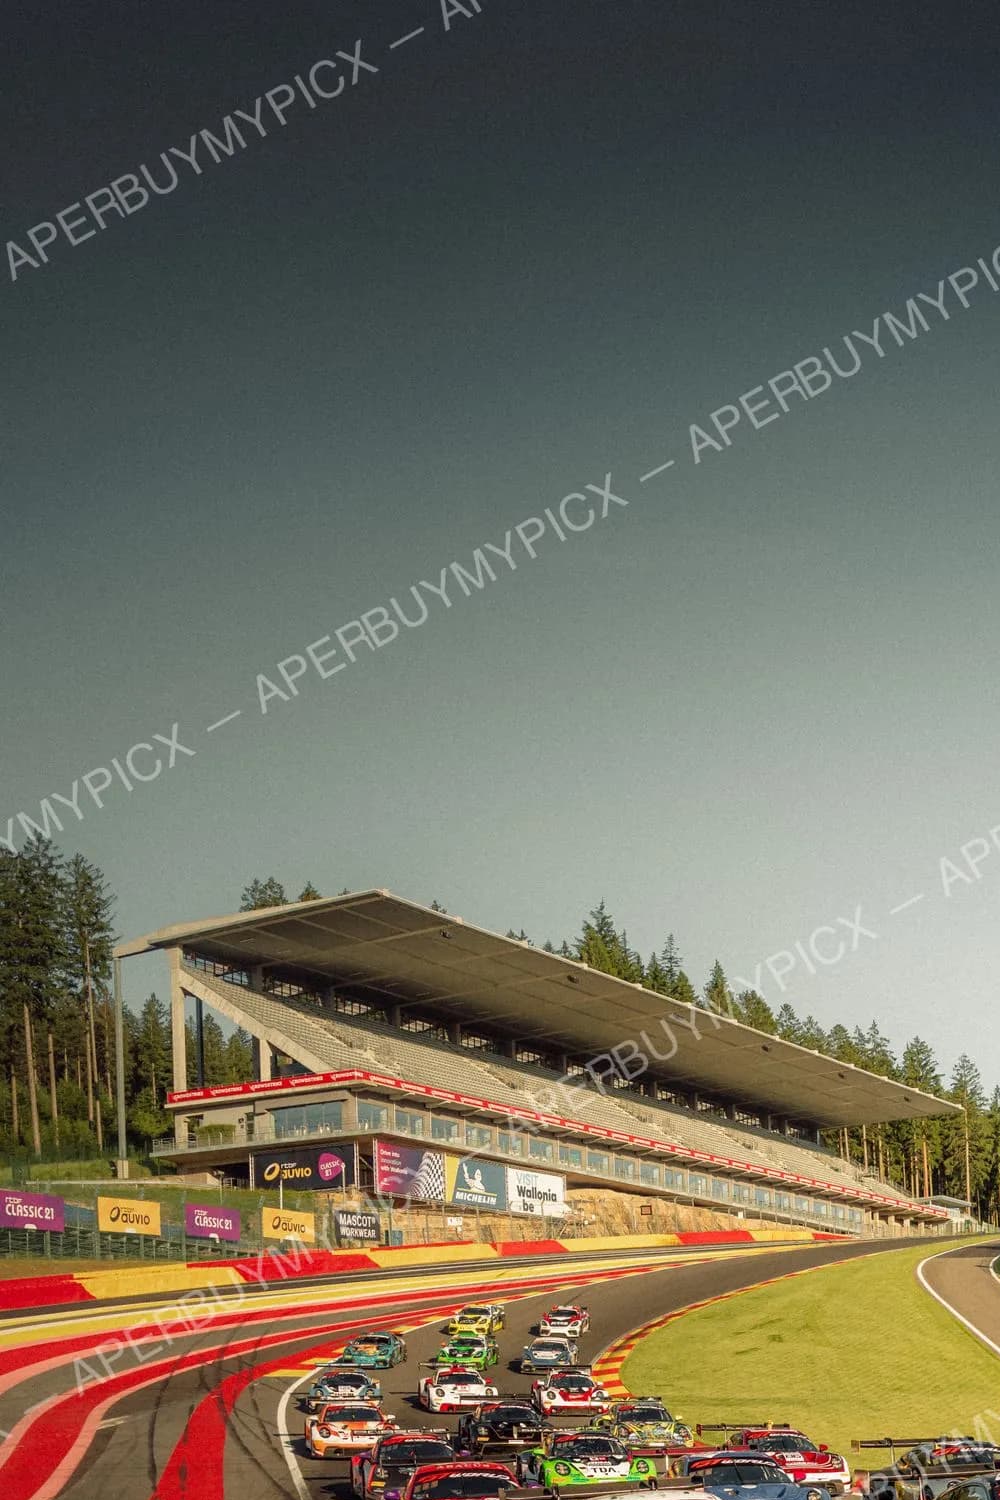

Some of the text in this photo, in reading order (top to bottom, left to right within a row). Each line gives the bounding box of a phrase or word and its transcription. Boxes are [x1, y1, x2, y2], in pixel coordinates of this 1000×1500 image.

[281, 1168, 312, 1179] auvio
[516, 1172, 538, 1185] VISIT
[455, 1191, 497, 1206] MICHELIN
[517, 1185, 558, 1202] Wallonia
[5, 1203, 55, 1220] CLASSIC 21
[121, 1212, 151, 1226] auvio
[194, 1216, 233, 1231] CLASSIC 21
[281, 1221, 306, 1234] auvio
[339, 1226, 377, 1239] WORKWEAR
